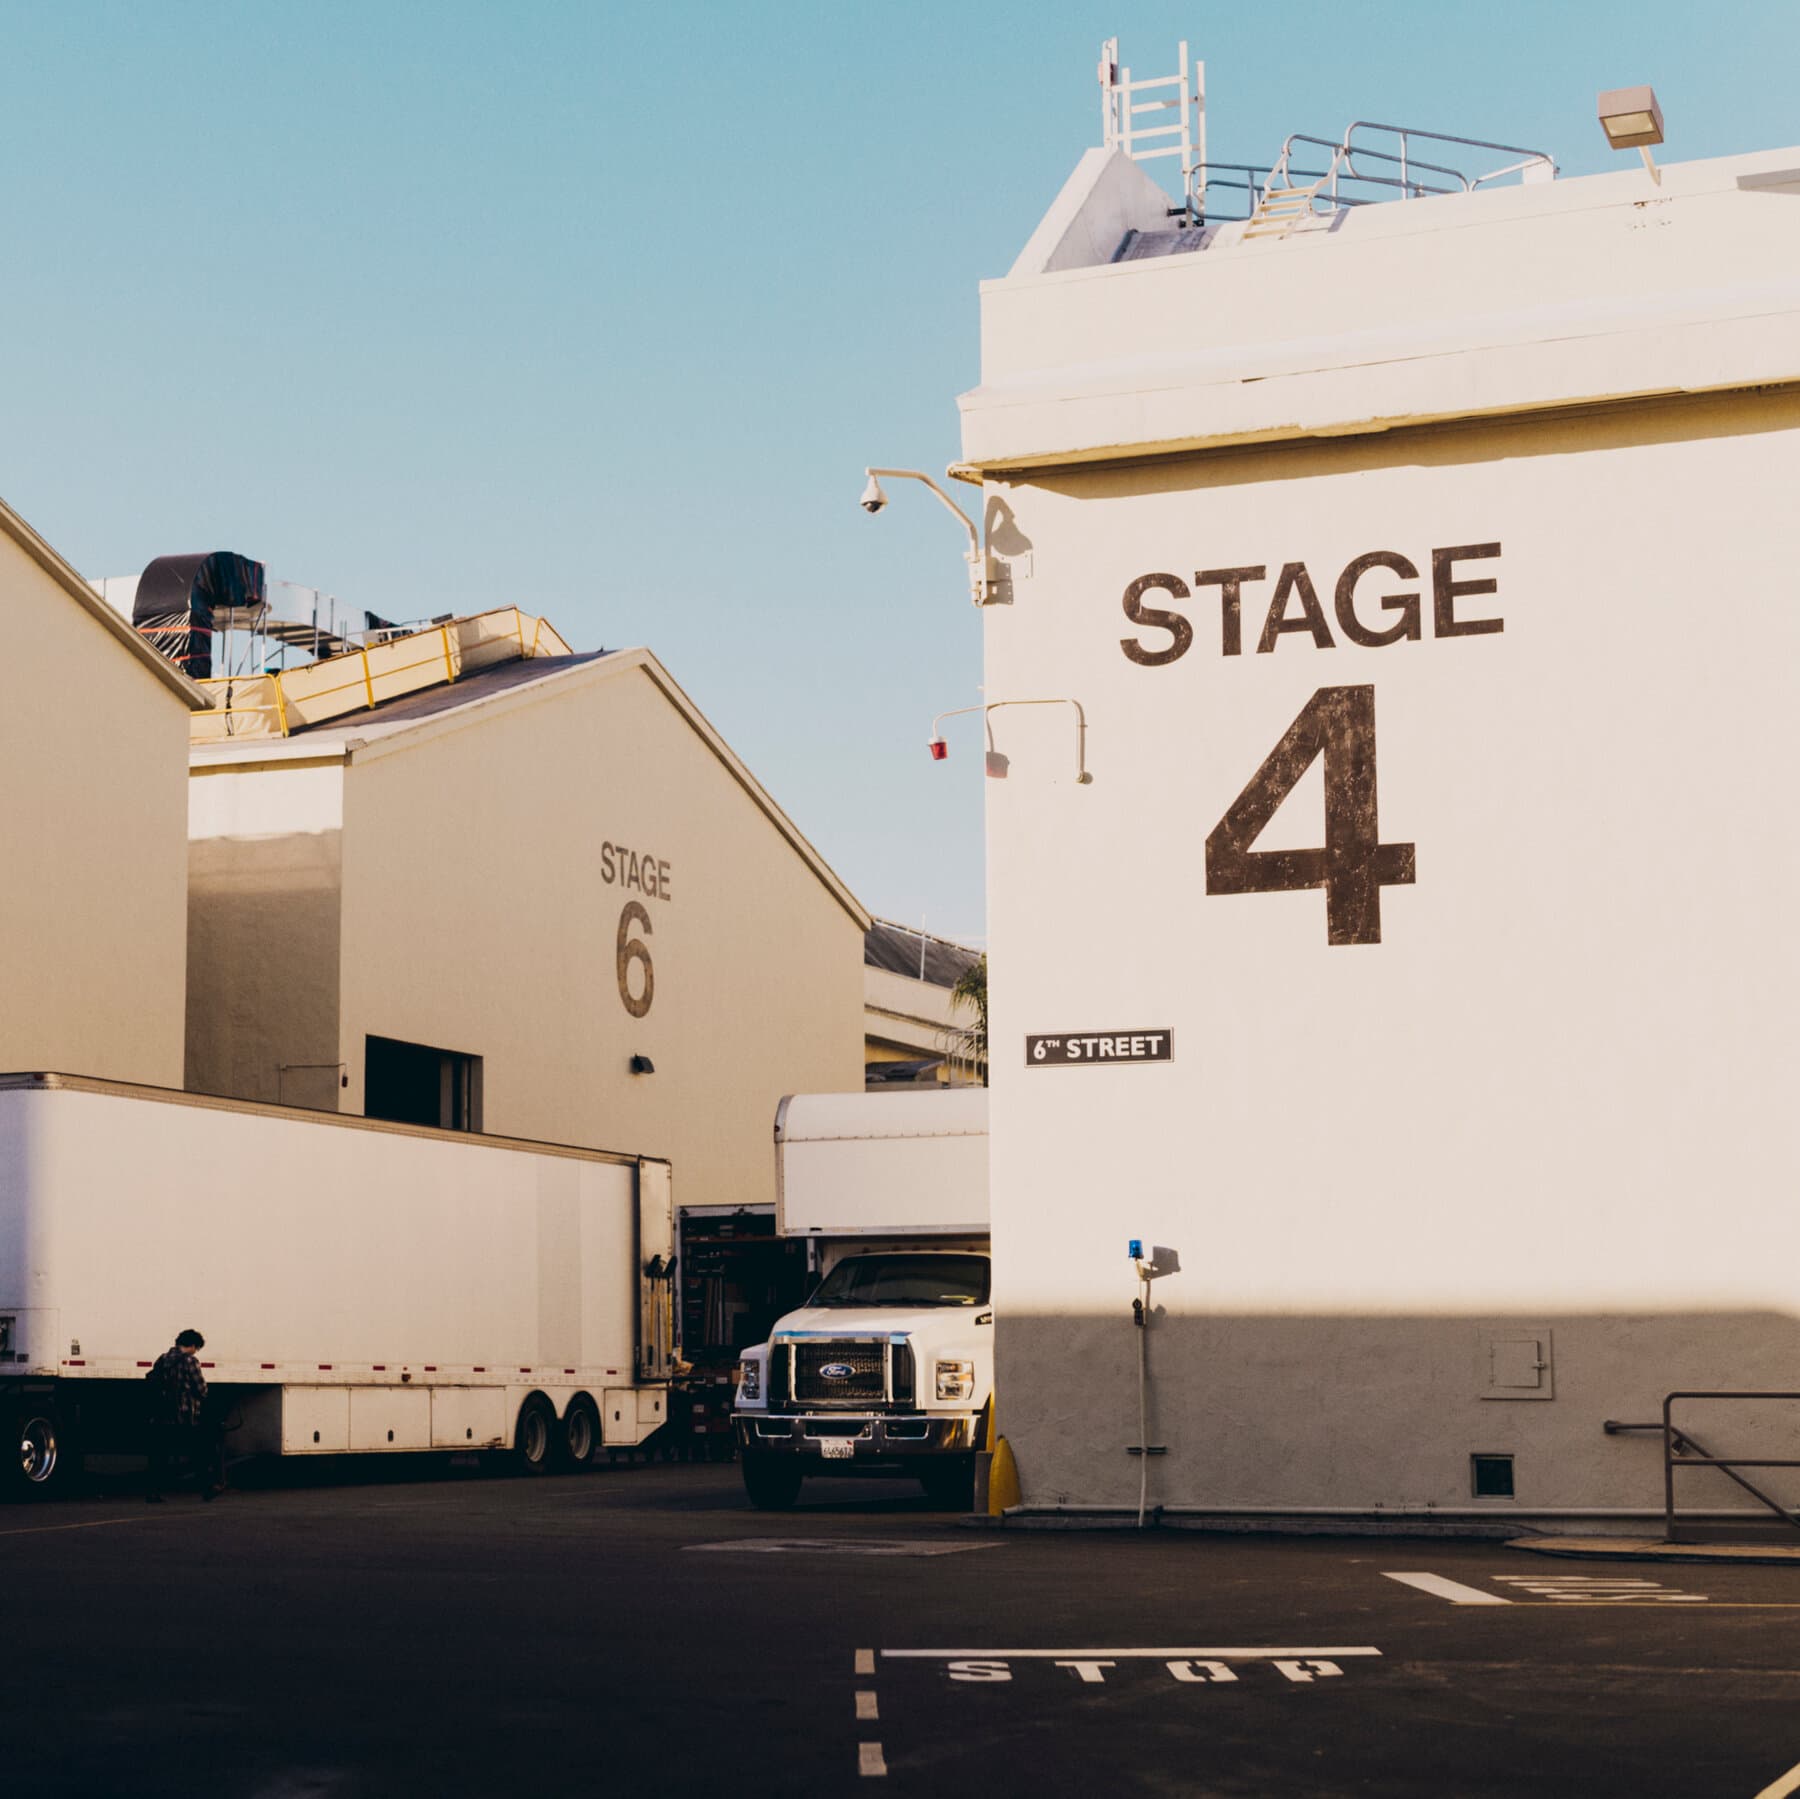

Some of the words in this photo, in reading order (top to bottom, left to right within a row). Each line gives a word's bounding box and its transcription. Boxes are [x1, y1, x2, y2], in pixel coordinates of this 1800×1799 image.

[1120, 542, 1504, 666] STAGE
[1205, 684, 1416, 946] 4
[601, 841, 671, 901] STAGE
[616, 901, 654, 1018] 6
[1033, 1039, 1060, 1060] 6TH
[1066, 1035, 1164, 1059] STREET
[949, 1661, 1344, 1682] STOP
